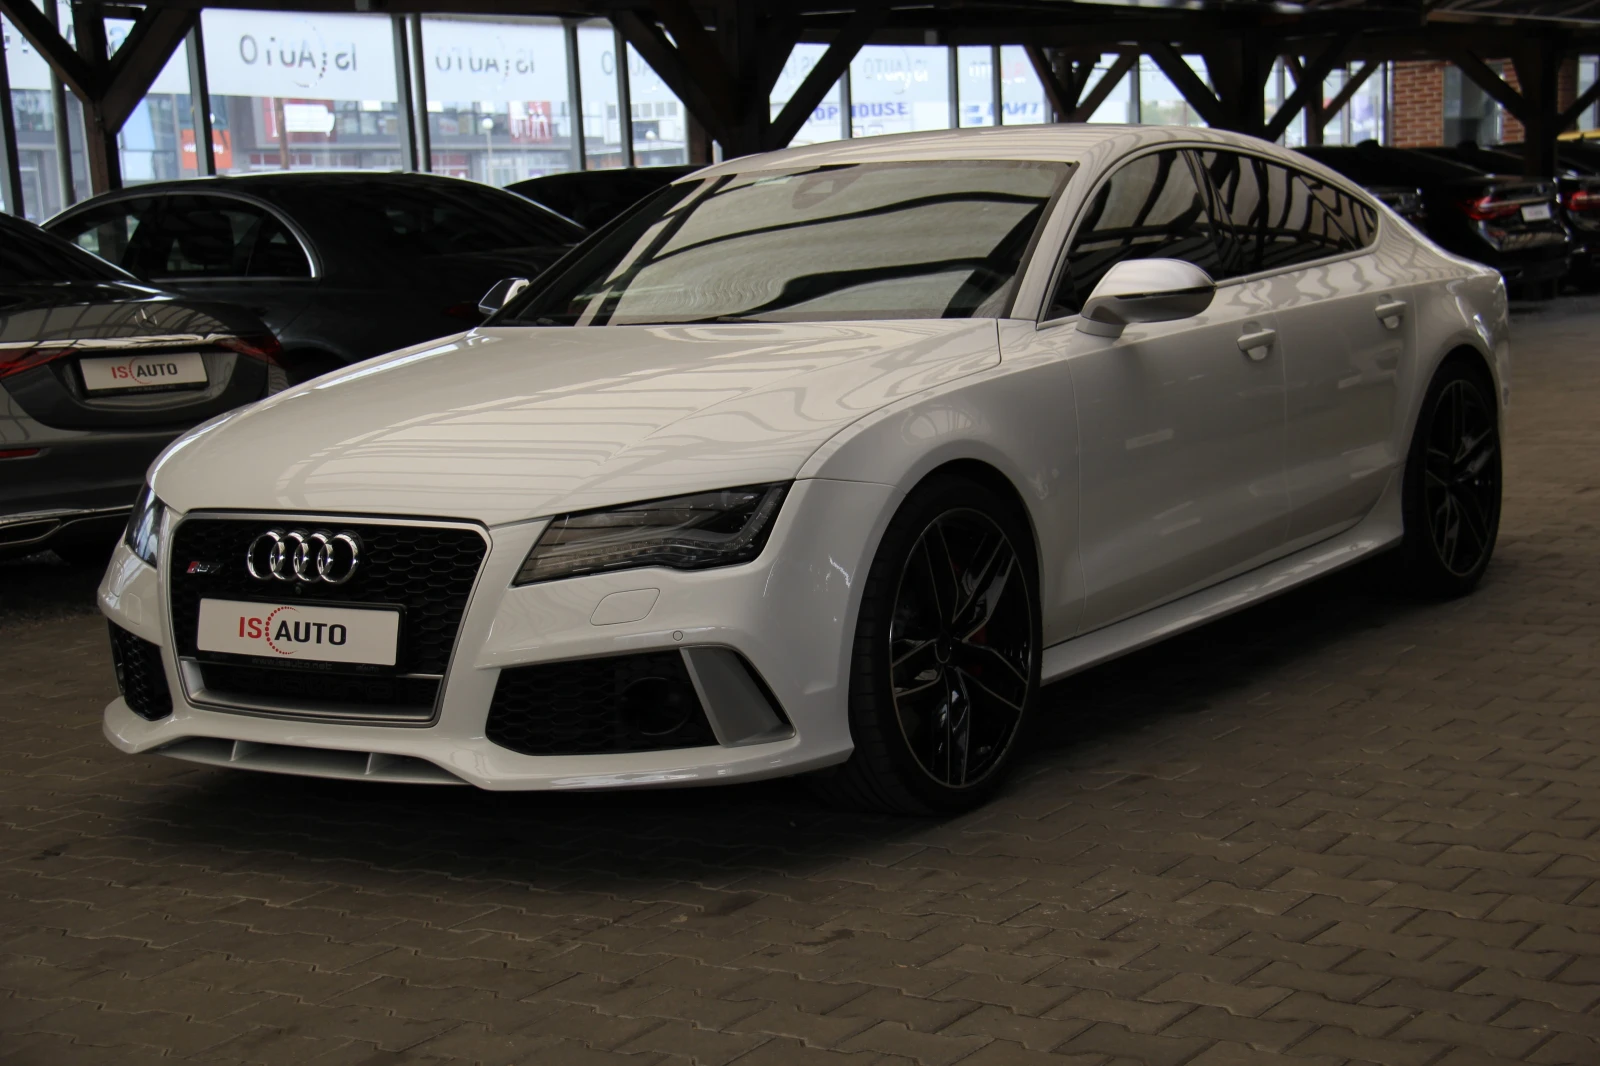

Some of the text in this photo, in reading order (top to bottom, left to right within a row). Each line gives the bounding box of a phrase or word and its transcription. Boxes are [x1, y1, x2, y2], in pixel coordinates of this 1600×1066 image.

[812, 105, 839, 121] OP
[111, 362, 178, 379] IS AUTO
[238, 616, 347, 646] IS AUTO
